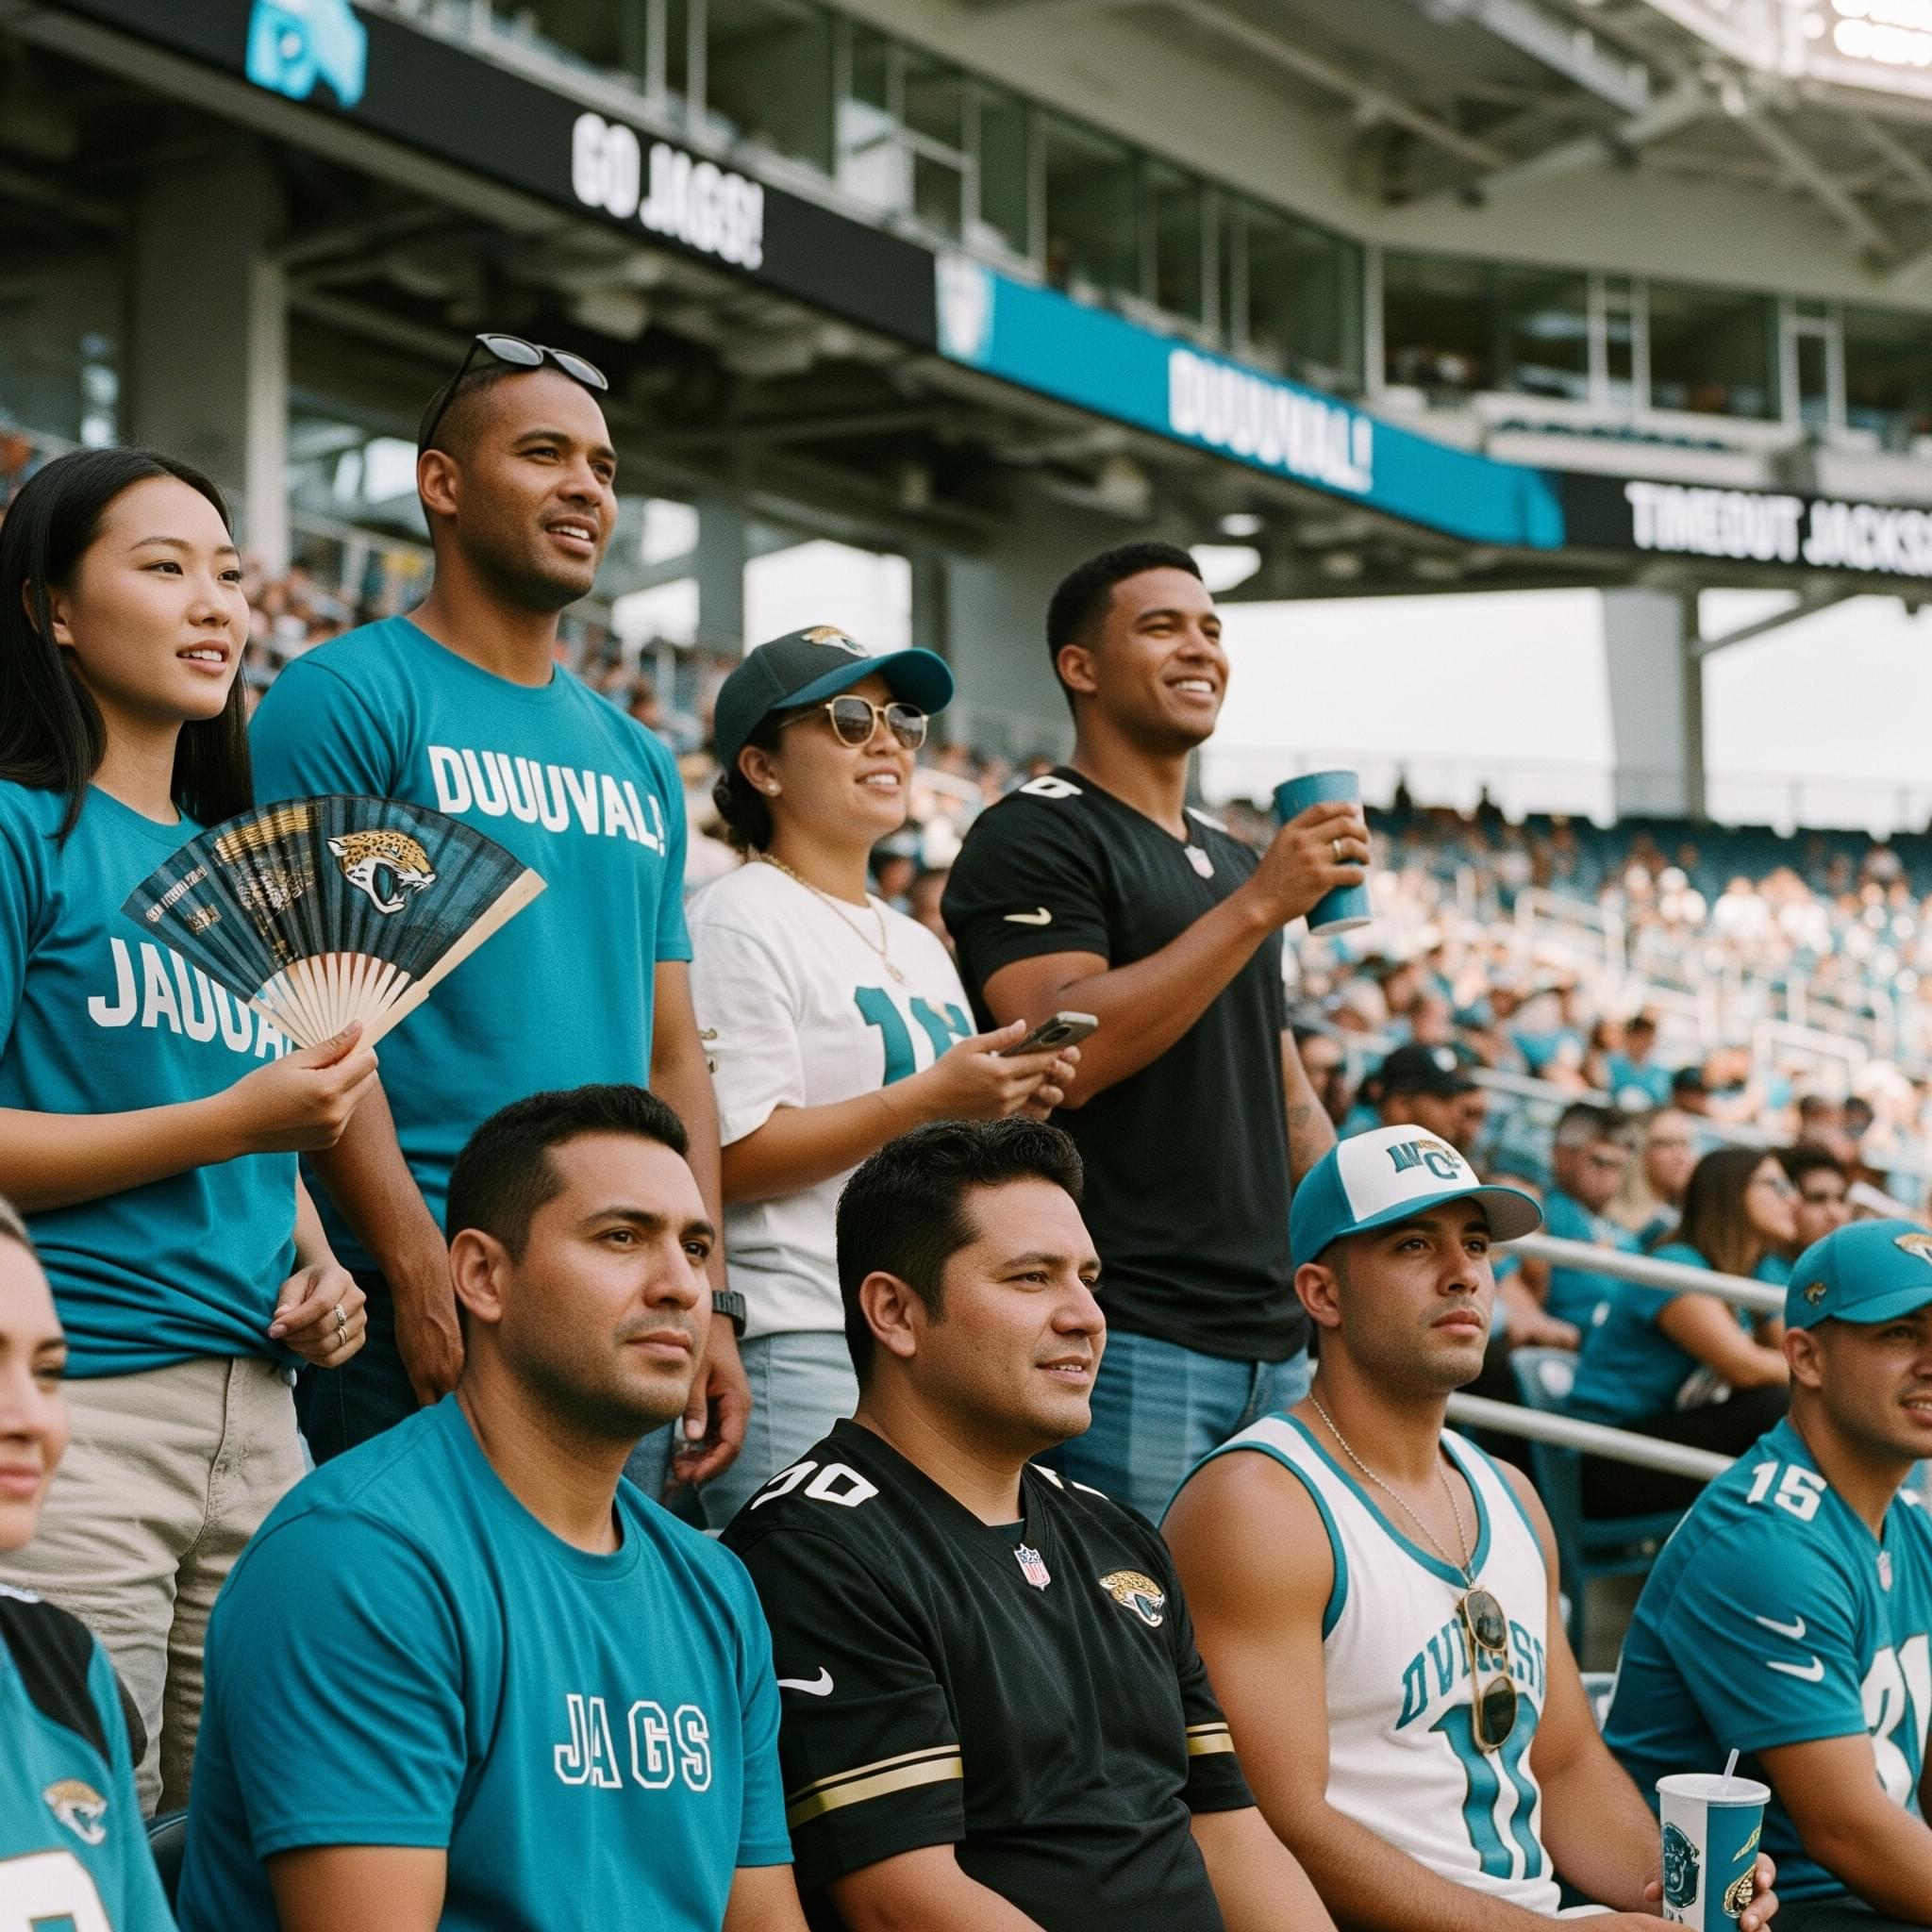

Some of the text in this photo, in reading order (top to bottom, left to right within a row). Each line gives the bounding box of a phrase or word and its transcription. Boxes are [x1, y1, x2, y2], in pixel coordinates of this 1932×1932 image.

[573, 112, 764, 271] GO JAGS!
[1624, 480, 1932, 578] TIMEOUT JACKS
[428, 745, 665, 858] DUUUVAL!
[1747, 1461, 1827, 1522] 15
